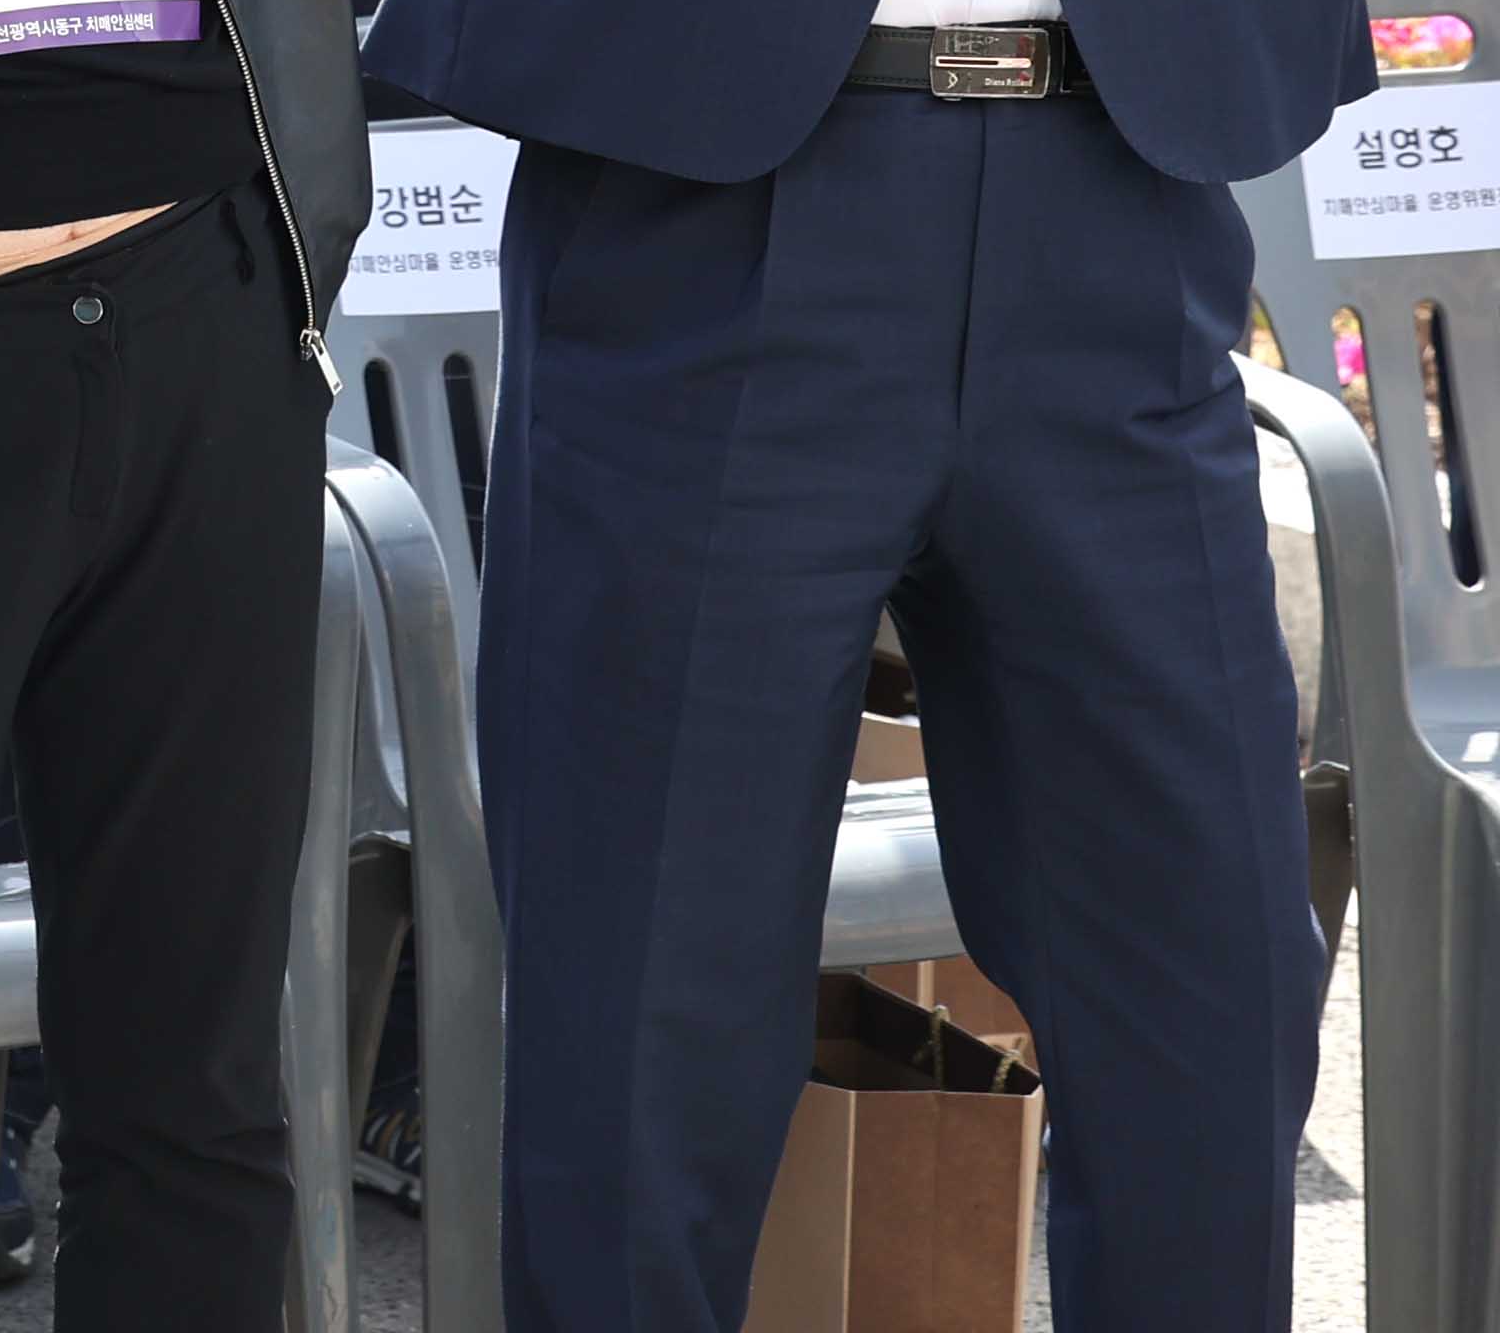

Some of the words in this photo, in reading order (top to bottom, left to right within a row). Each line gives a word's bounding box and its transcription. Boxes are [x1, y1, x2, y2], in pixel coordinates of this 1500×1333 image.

[86, 12, 155, 33] 치매안심센터
[1353, 126, 1464, 171] 설영호
[377, 184, 484, 229] 강범순
[1427, 187, 1500, 212] 운영위원
[450, 248, 498, 271] 운영위
